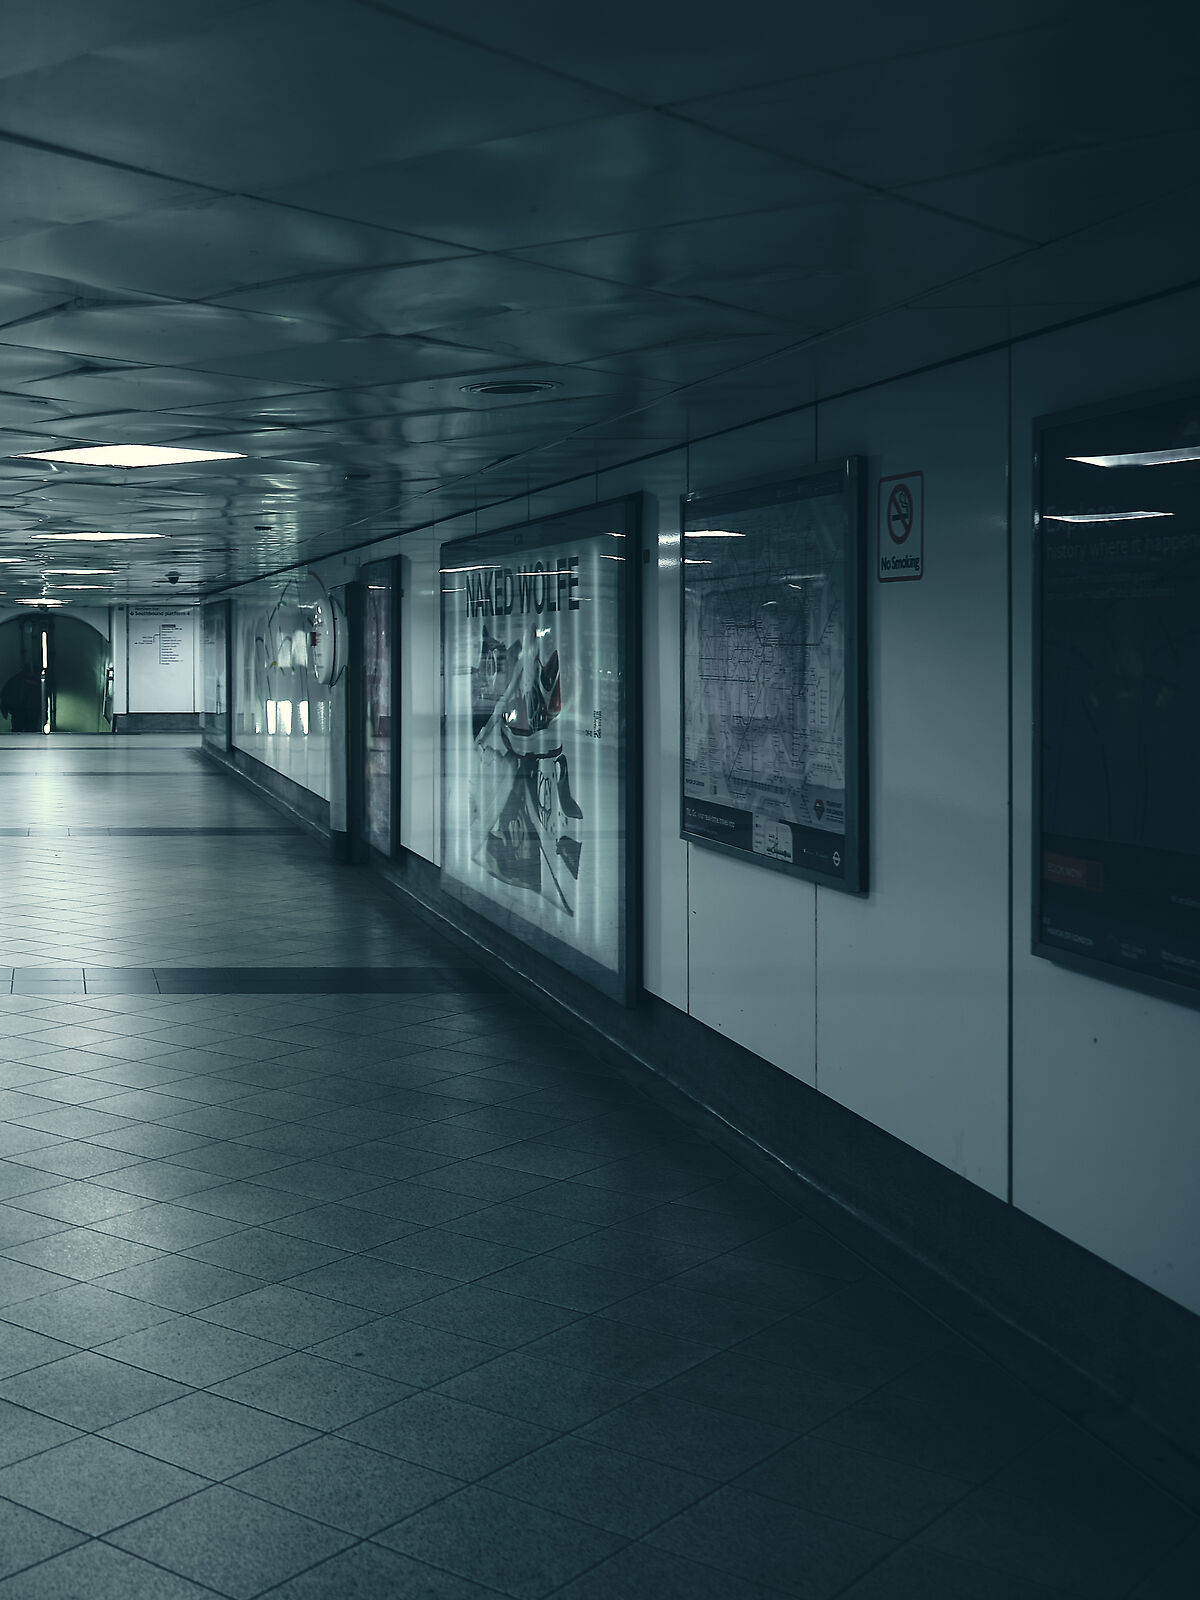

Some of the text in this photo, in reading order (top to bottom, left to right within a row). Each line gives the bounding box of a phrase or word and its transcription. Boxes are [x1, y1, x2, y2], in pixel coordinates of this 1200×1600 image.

[881, 555, 920, 571] No Smoking
[466, 557, 579, 617] NAKED WOLFE
